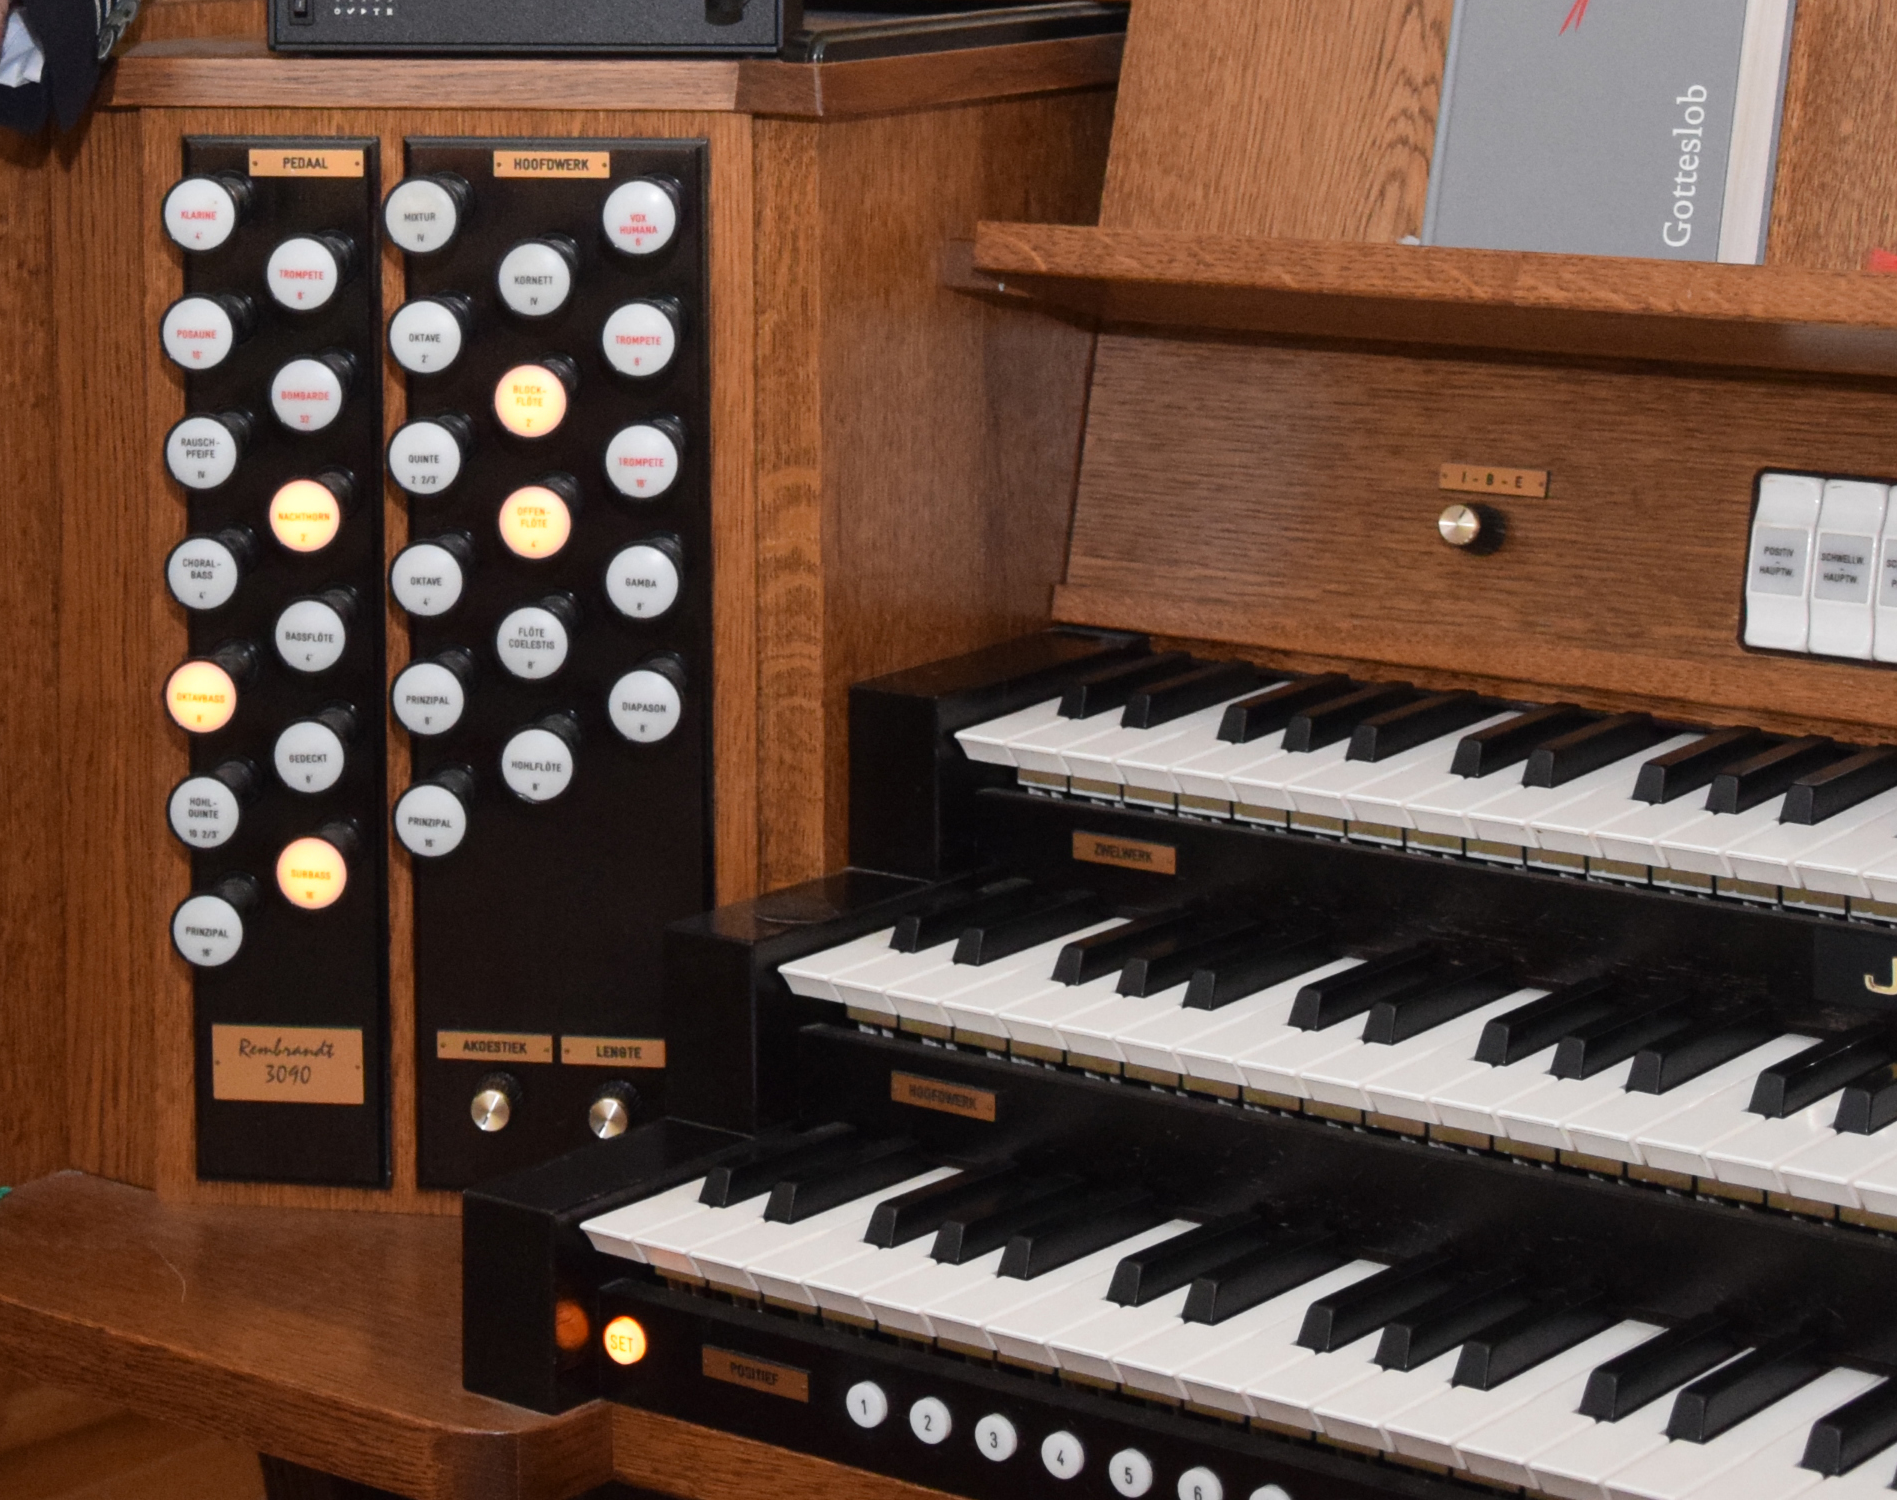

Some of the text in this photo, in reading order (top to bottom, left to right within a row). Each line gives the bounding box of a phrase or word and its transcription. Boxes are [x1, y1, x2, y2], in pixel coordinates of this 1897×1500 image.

[282, 157, 329, 169] PEDAAL
[513, 158, 590, 171] HOOFDWERK
[1662, 84, 1708, 247] Gotteslob
[180, 210, 218, 221] KLARINE
[404, 212, 436, 222] MIXTUR
[630, 213, 647, 223] VOX
[619, 225, 659, 236] HUMANA
[416, 233, 425, 242] IV
[279, 268, 325, 280] TROMPETE
[514, 275, 554, 286] KORNETT
[530, 296, 538, 306] IV
[176, 329, 217, 340] POSAUNE
[408, 333, 441, 344] OKTAVE
[615, 335, 662, 346] TROMPETE
[281, 391, 331, 401] BOMBARDE
[512, 385, 547, 396] BLOCK-
[516, 396, 544, 408] FLÖTE
[180, 437, 221, 448] RAUSCH-
[186, 449, 216, 460] PFEIFE
[408, 455, 440, 465] QUINTE
[618, 456, 665, 468] TROMPETE
[277, 512, 331, 522] NACHTHORN
[517, 506, 551, 517] OFFEN-
[520, 517, 548, 529] FLÖTE
[1763, 546, 1795, 558] POSITIV
[182, 558, 222, 569] CHORAL-
[190, 570, 214, 580] BASS
[410, 576, 443, 587] OKTAVE
[625, 577, 658, 588] GAMBA
[285, 631, 335, 644] BASSFLÖTE
[517, 626, 546, 638] FLÖTE
[508, 638, 556, 650] COELESTIS
[176, 691, 226, 704] OKTAVBASS
[405, 694, 451, 706] PRINZIPAL
[621, 701, 667, 714] DIAPASON
[288, 754, 328, 764] GEDECKT
[511, 760, 563, 773] HOHLFLÖTE
[189, 797, 218, 808] HOHL-
[407, 816, 453, 830] PRINZIPAL
[290, 868, 332, 881] SUBBASS
[185, 925, 230, 939] PRINZIPAL
[238, 1037, 335, 1060] Rembrandt
[462, 1039, 528, 1055] AKOESTIEK
[595, 1044, 643, 1060] LENGTE
[264, 1064, 312, 1086] 3090
[609, 1333, 634, 1354] SET
[729, 1361, 779, 1386] POSITIEF
[860, 1398, 868, 1416] 1
[923, 1414, 933, 1432] 2
[989, 1431, 998, 1449] 3
[1056, 1449, 1065, 1467] 4
[1124, 1467, 1134, 1485] 5
[1193, 1484, 1203, 1500] 6
